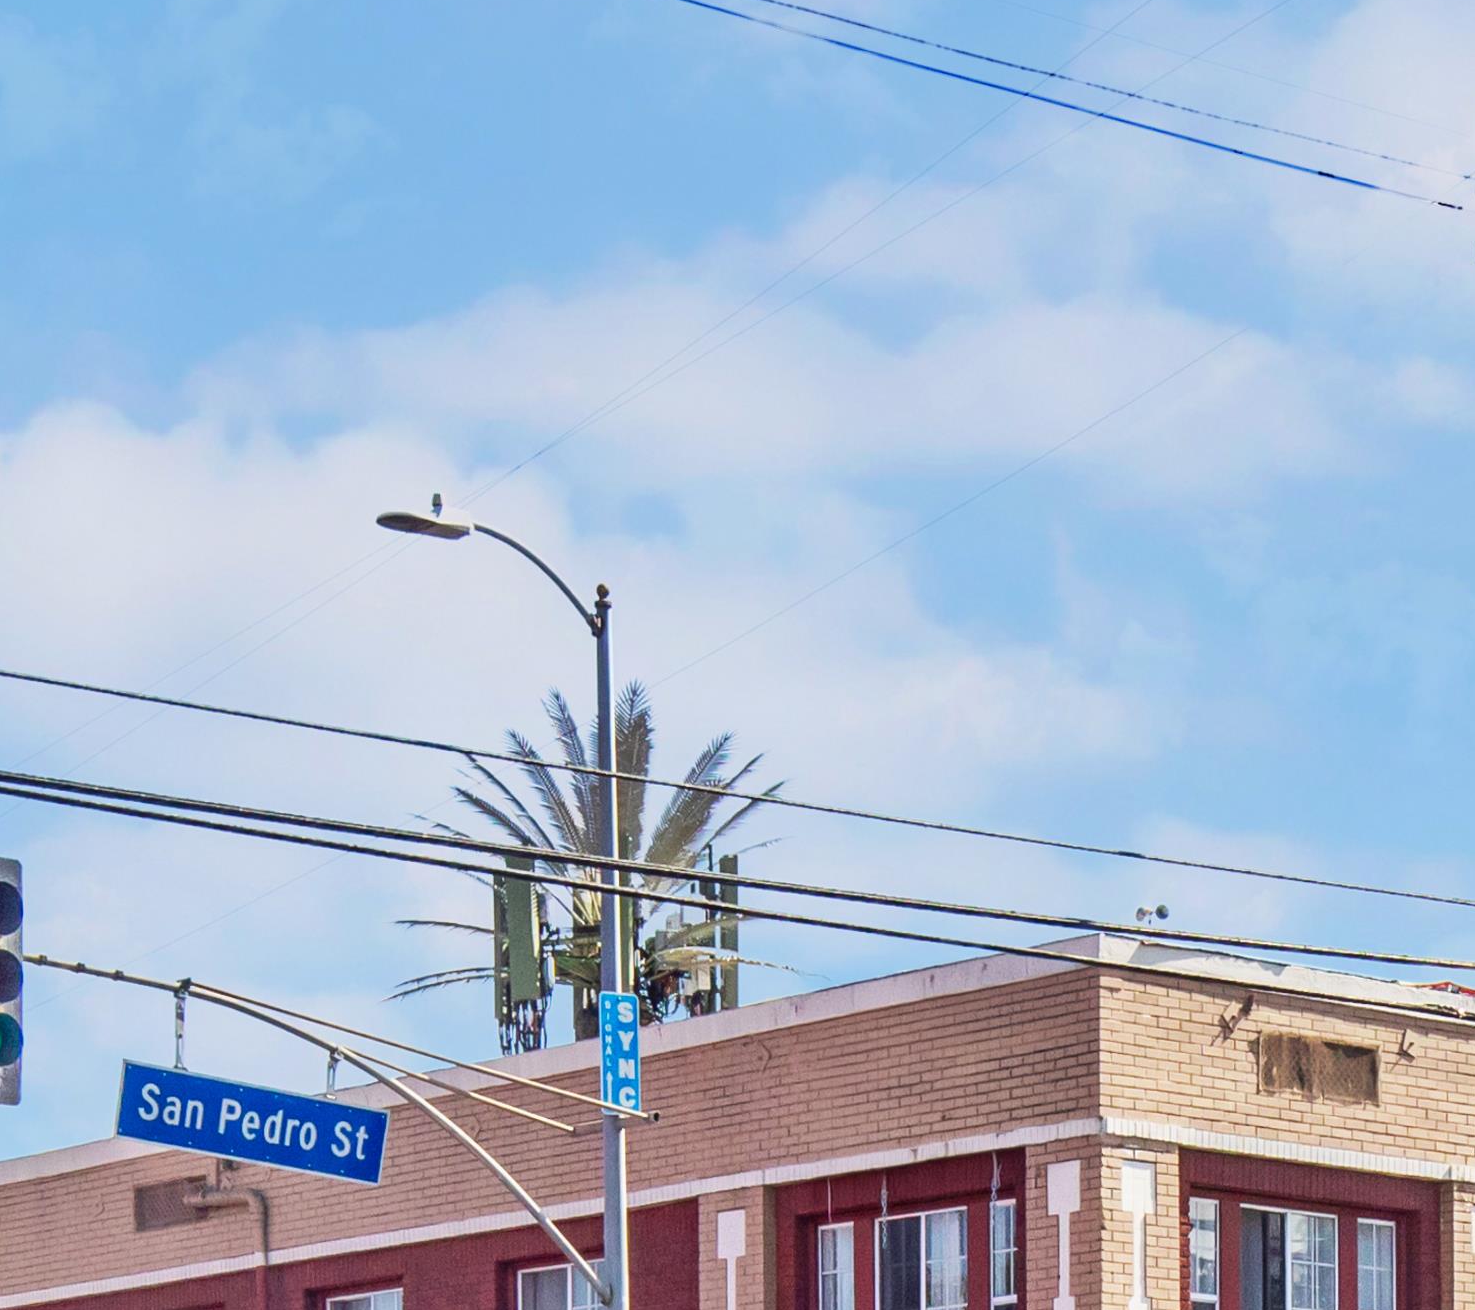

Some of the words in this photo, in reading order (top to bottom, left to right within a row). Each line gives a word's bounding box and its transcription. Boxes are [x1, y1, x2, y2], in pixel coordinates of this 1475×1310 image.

[617, 1001, 638, 1108] SYNC
[138, 1083, 204, 1130] San
[218, 1098, 317, 1151] Pedro
[330, 1121, 369, 1160] St
